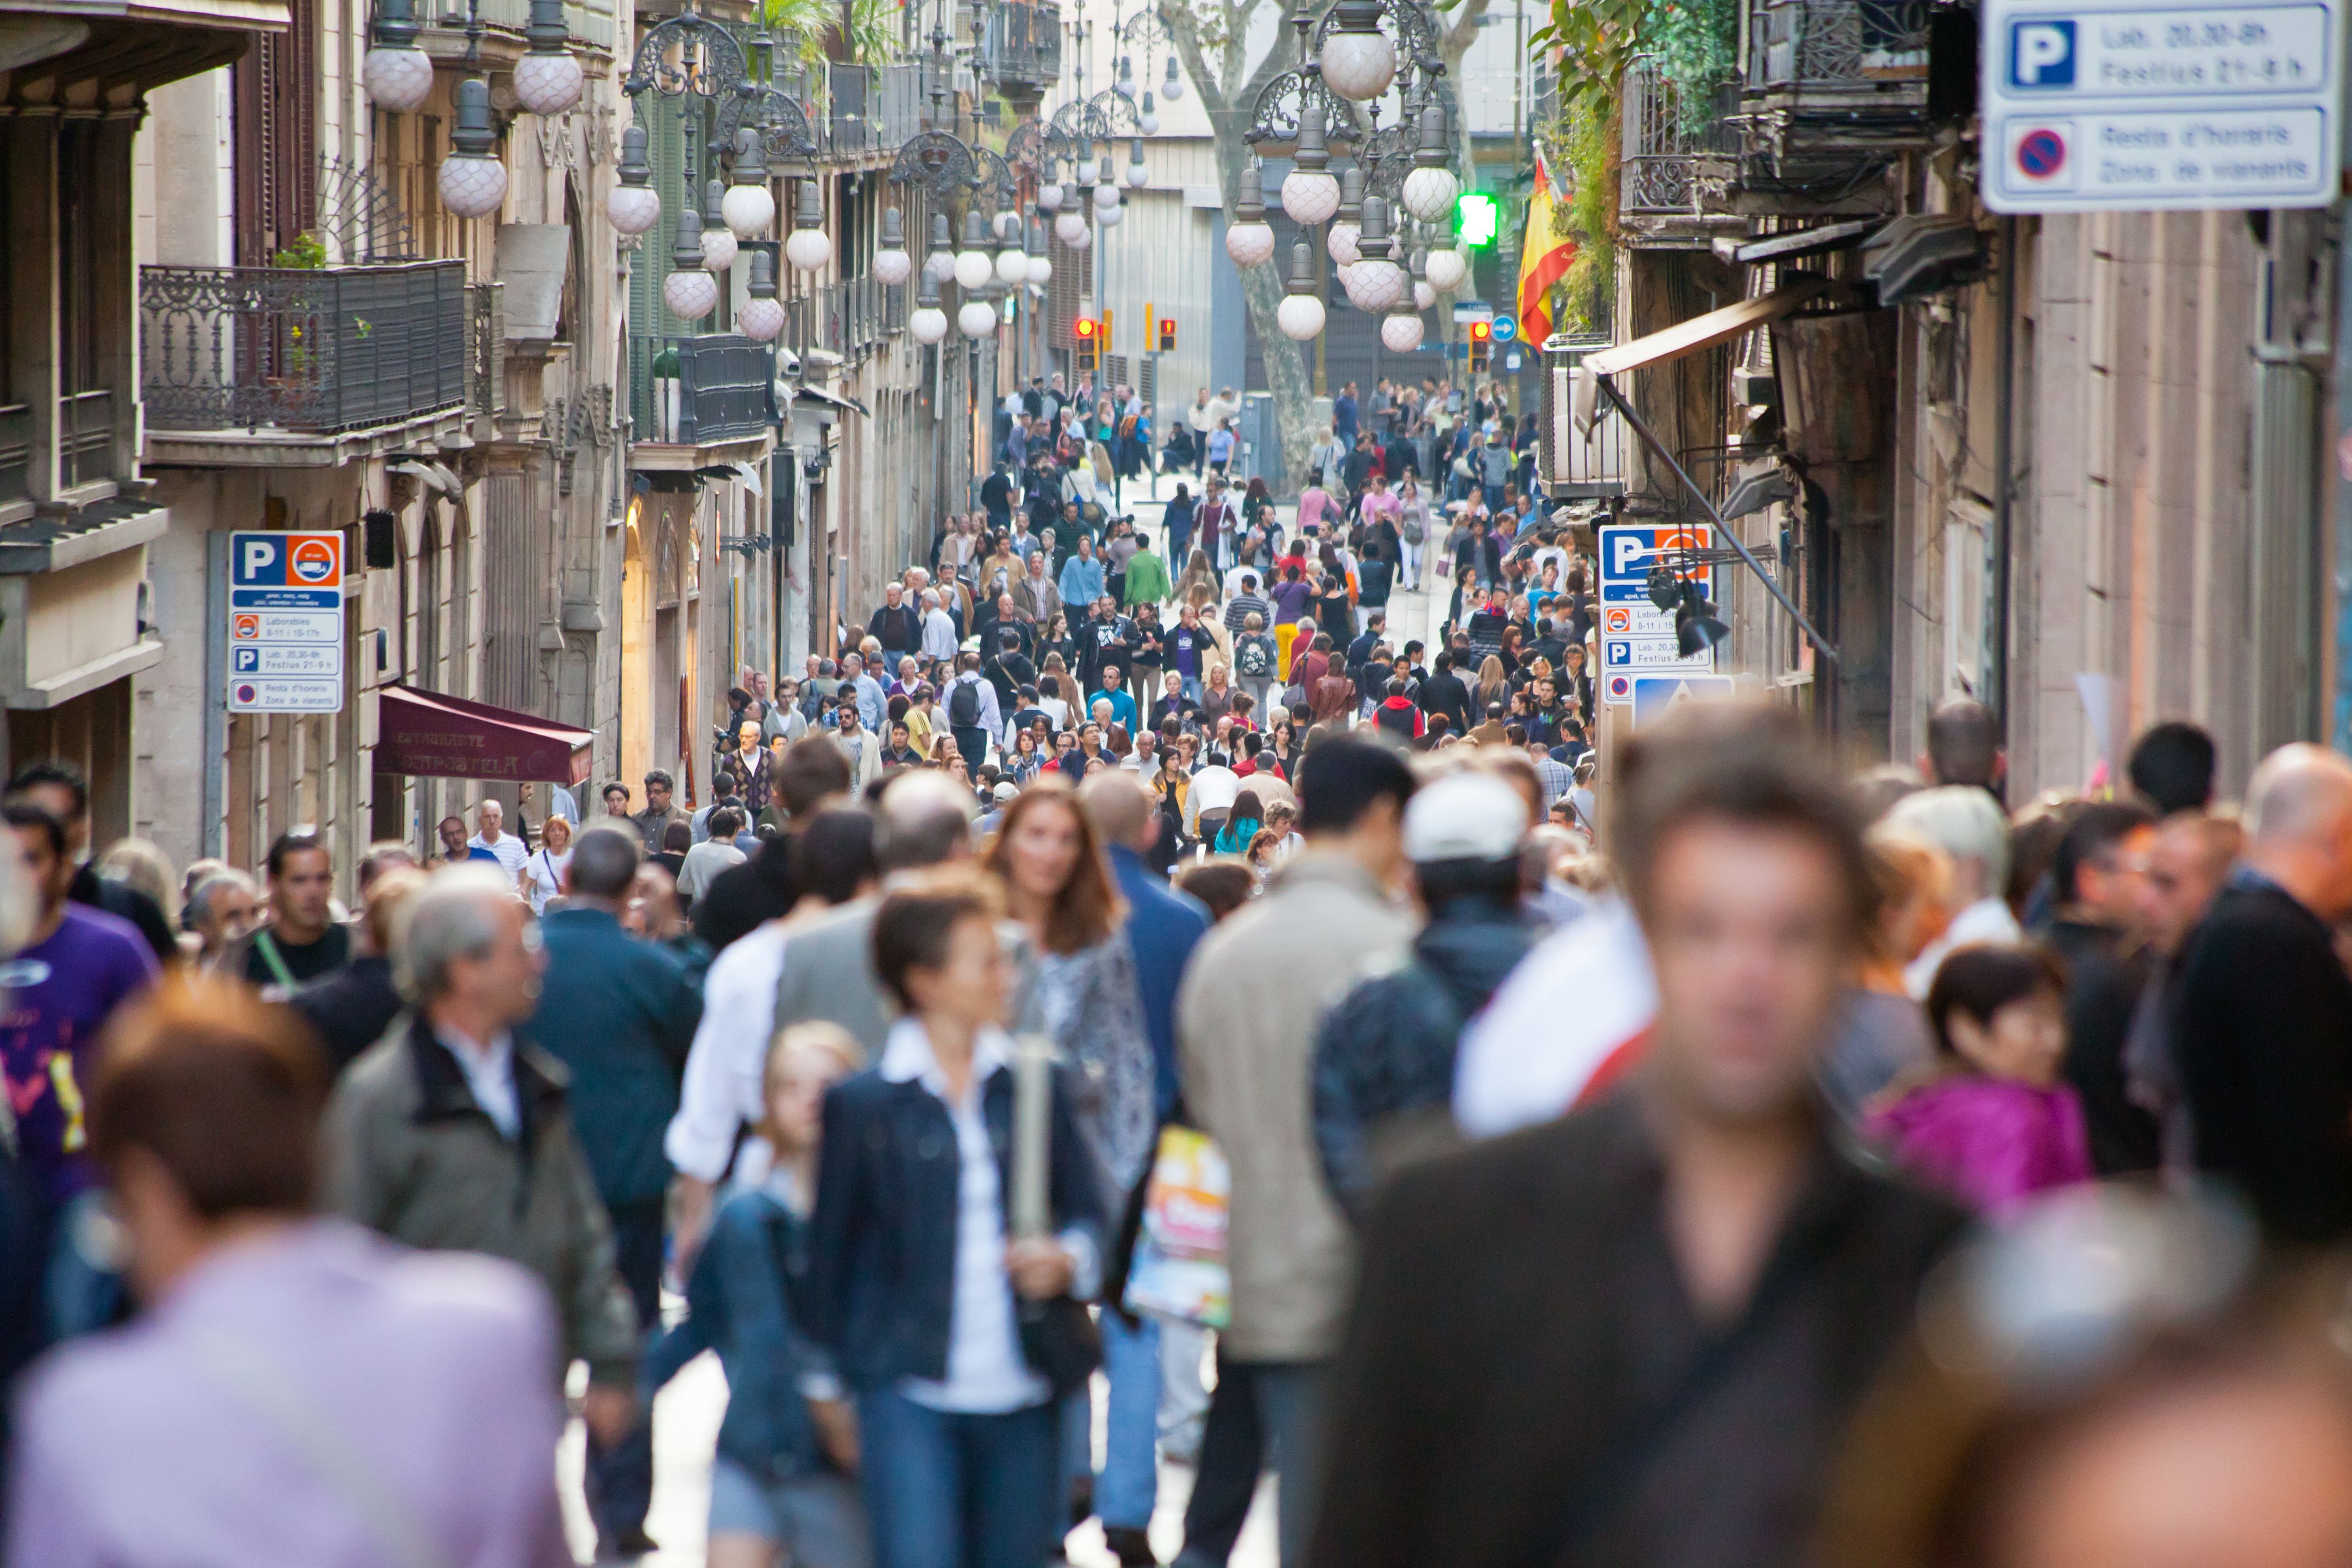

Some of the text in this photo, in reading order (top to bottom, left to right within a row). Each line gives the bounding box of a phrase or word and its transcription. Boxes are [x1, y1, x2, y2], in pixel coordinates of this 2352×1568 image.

[2017, 24, 2068, 85] P
[244, 541, 275, 579] P
[1614, 536, 1644, 574] P
[266, 617, 311, 625] Laborables
[1638, 622, 1654, 630] 8-11
[1611, 644, 1626, 663] P
[1658, 643, 1680, 651] 20,30
[238, 650, 255, 670] P
[266, 661, 300, 669] Festius
[1638, 654, 1672, 662] Festius
[391, 731, 485, 748] ESTAURANTE
[393, 751, 519, 775] OMPOSTELA
